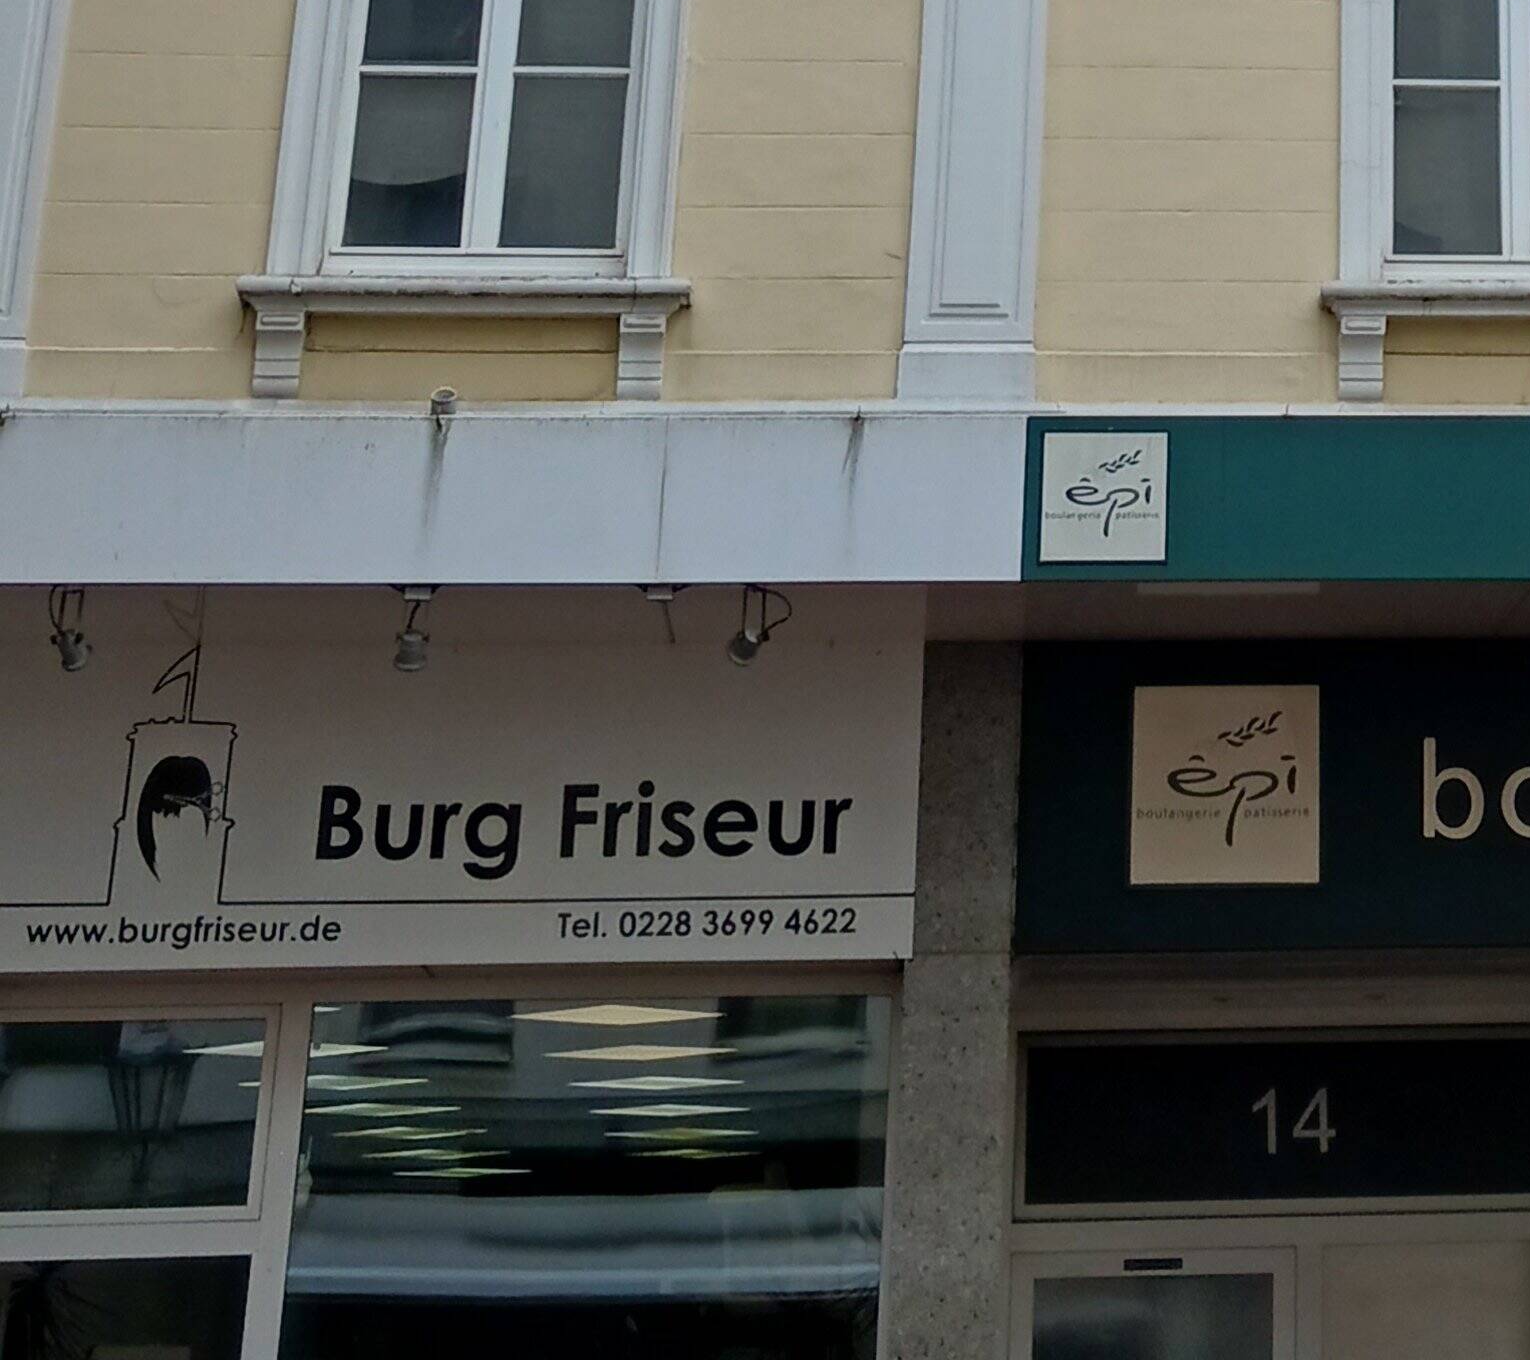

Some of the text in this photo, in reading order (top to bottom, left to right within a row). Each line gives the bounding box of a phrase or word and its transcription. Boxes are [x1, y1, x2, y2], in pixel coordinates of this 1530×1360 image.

[315, 780, 853, 881] Burg Friseur
[1136, 806, 1310, 822] boulangerie patisserie
[26, 915, 342, 950] www.burgfriseur.de
[557, 907, 857, 939] Tel. 0228 3699 4622
[1250, 1086, 1337, 1155] 14
